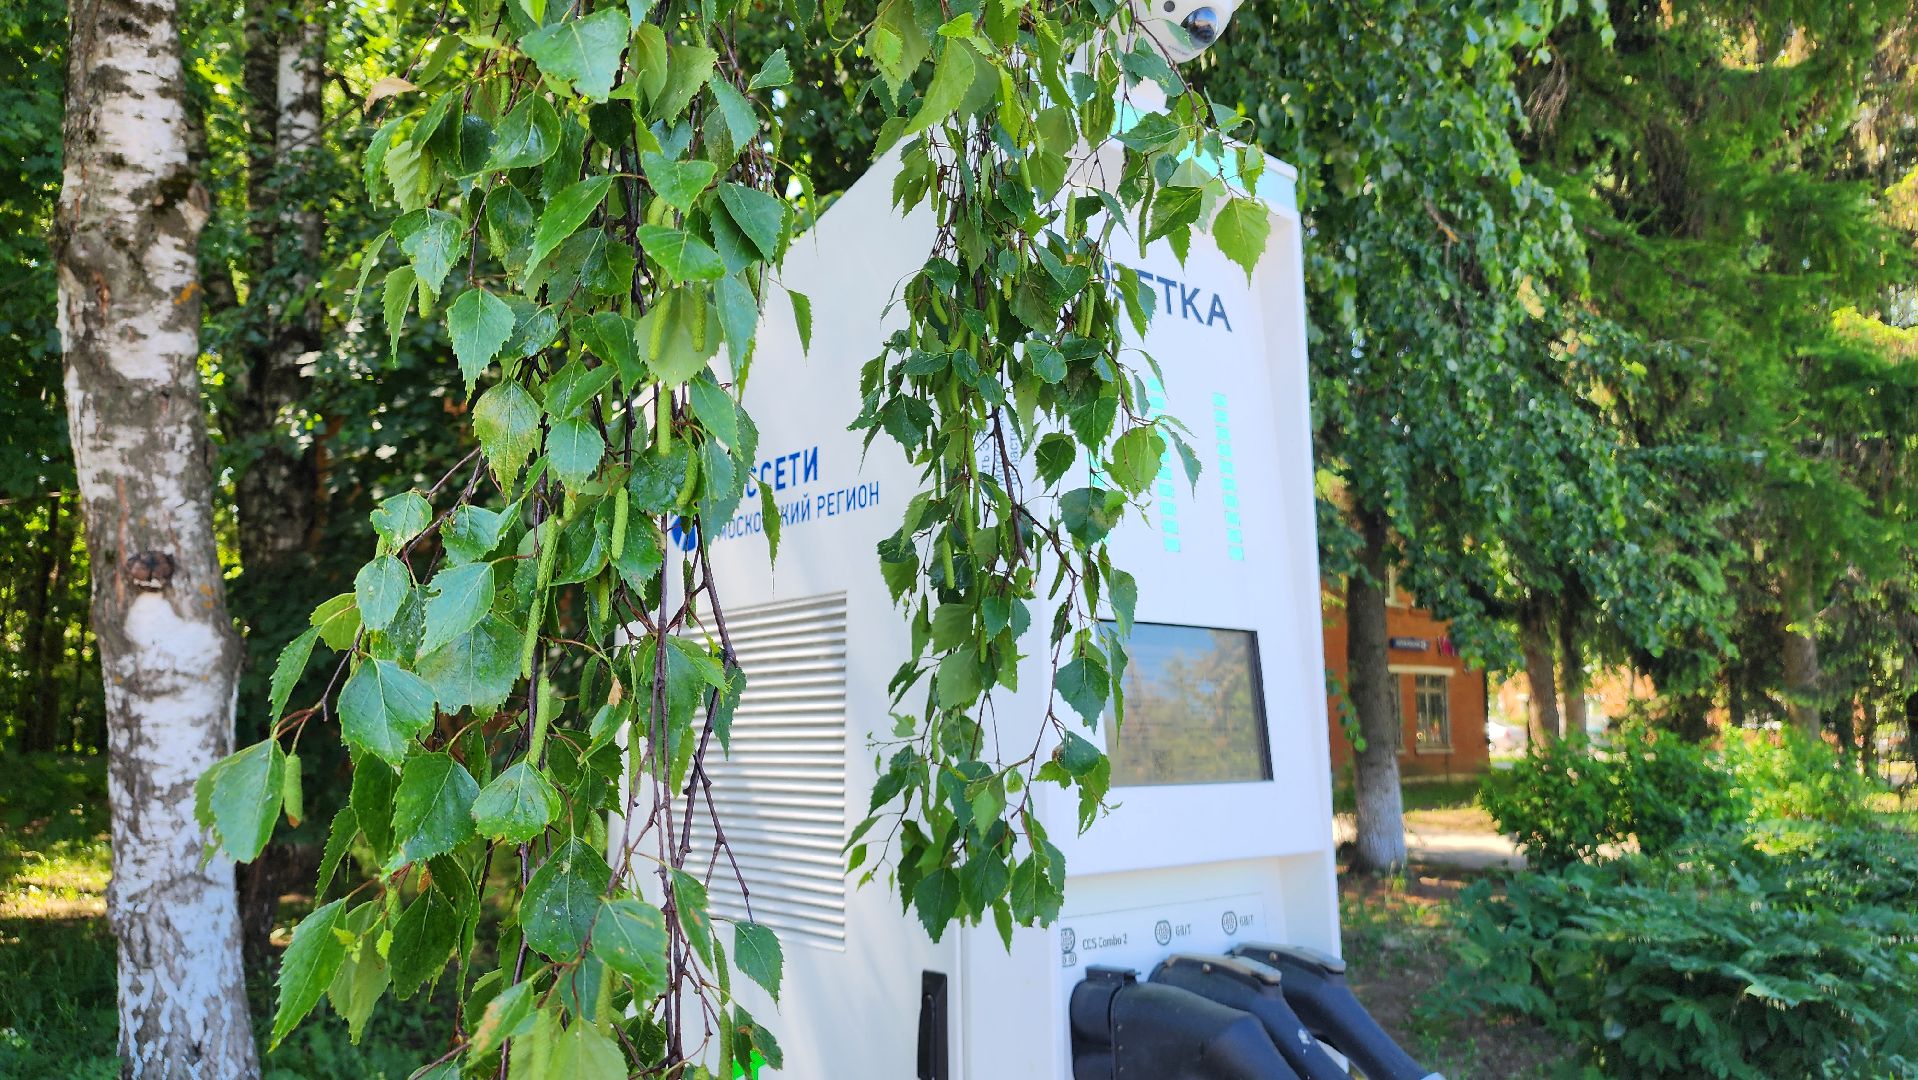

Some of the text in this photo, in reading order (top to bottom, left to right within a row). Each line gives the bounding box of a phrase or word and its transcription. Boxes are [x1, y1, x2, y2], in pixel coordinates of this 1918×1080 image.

[746, 446, 818, 498] ССЕТИ
[817, 481, 879, 519] РЕГИОН
[1082, 933, 1128, 950] CCS Combo 2
